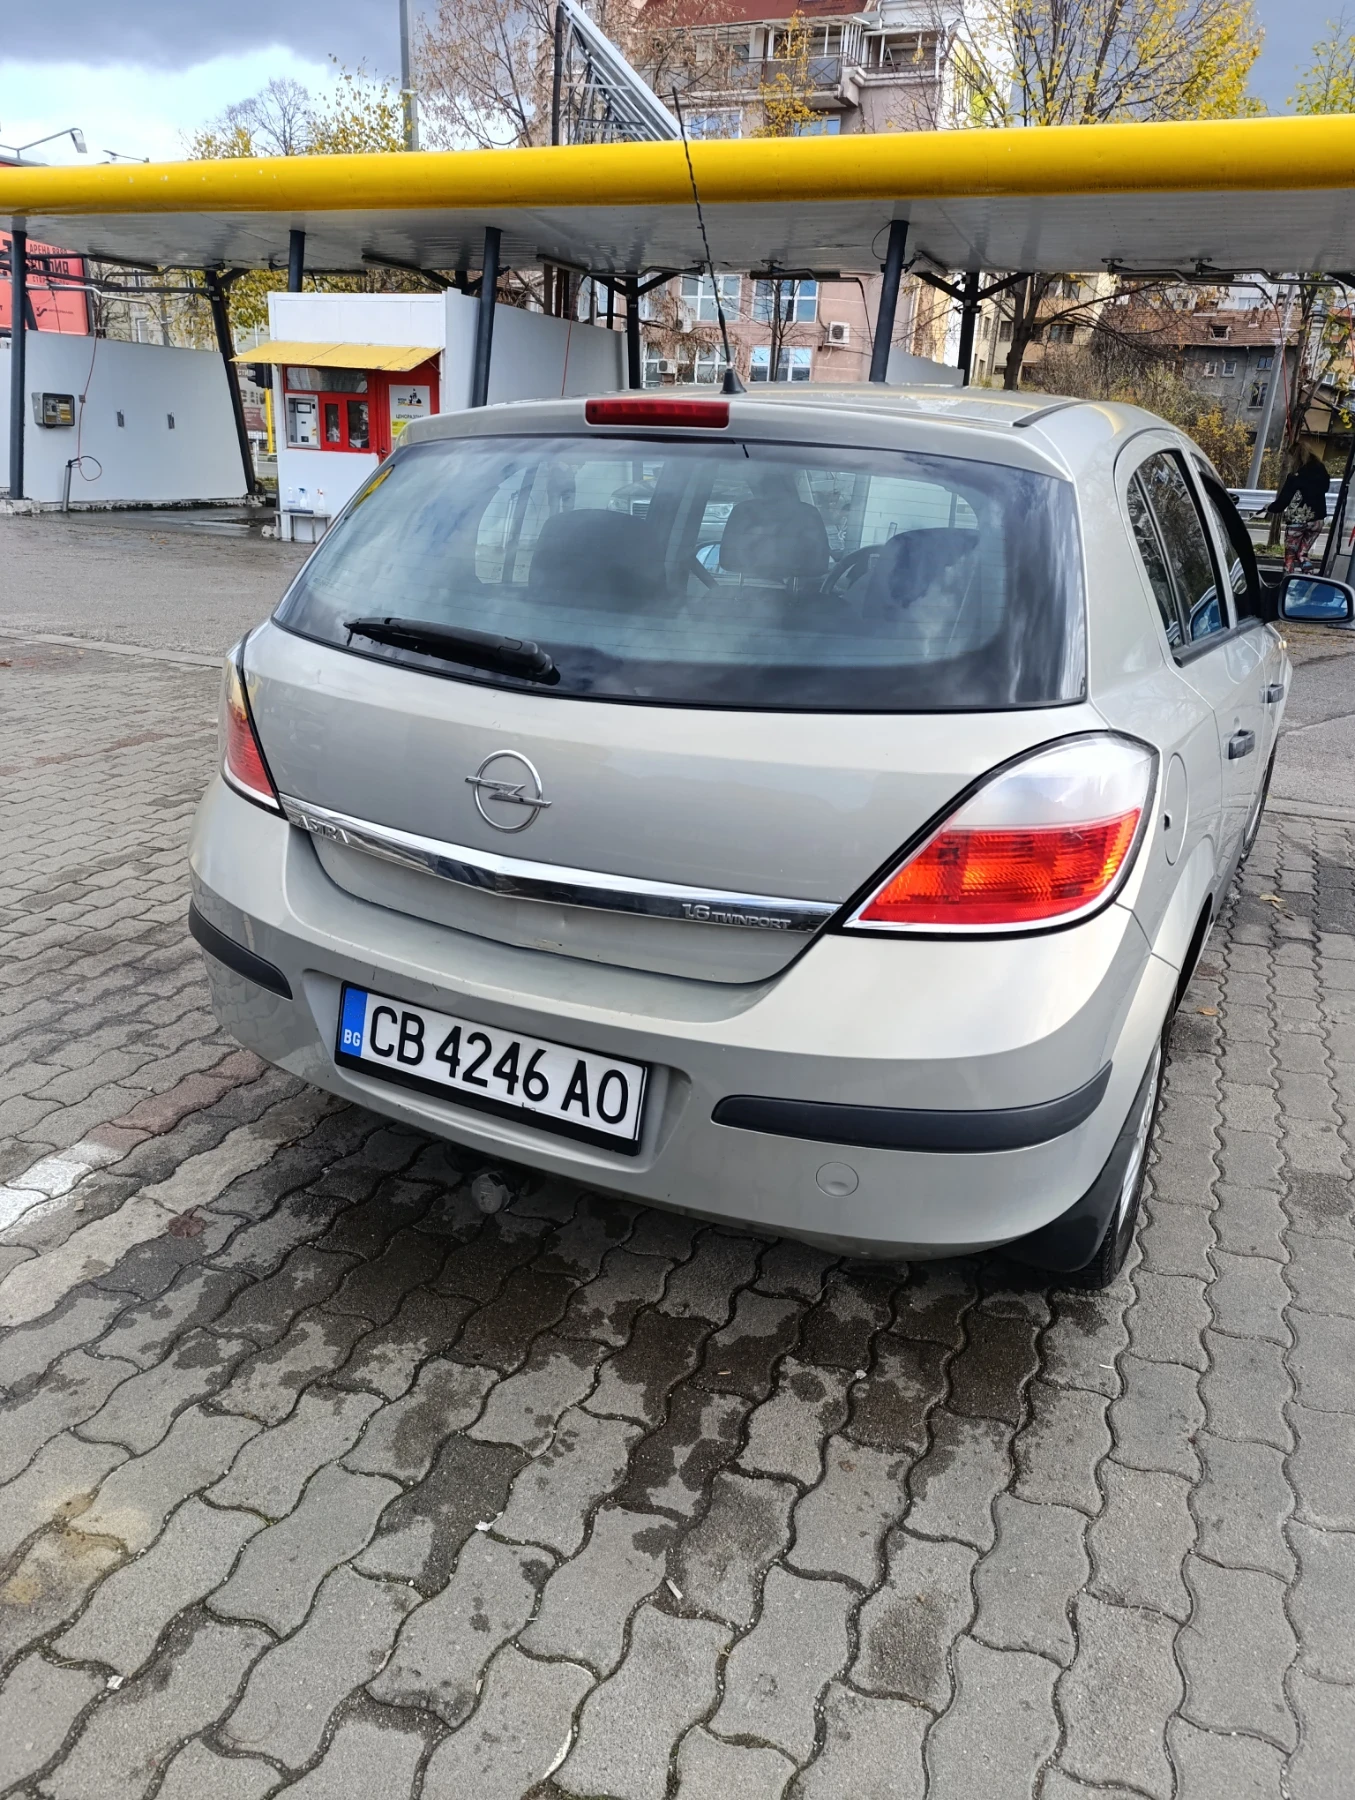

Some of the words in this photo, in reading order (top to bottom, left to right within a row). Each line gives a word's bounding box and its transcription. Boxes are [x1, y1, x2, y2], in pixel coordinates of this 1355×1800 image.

[298, 815, 348, 844] ASTRA
[711, 911, 792, 930] TWINPORT
[343, 1028, 361, 1047] BG
[369, 1005, 425, 1066] CB
[435, 1025, 549, 1102] 4246
[560, 1059, 629, 1125] AO
